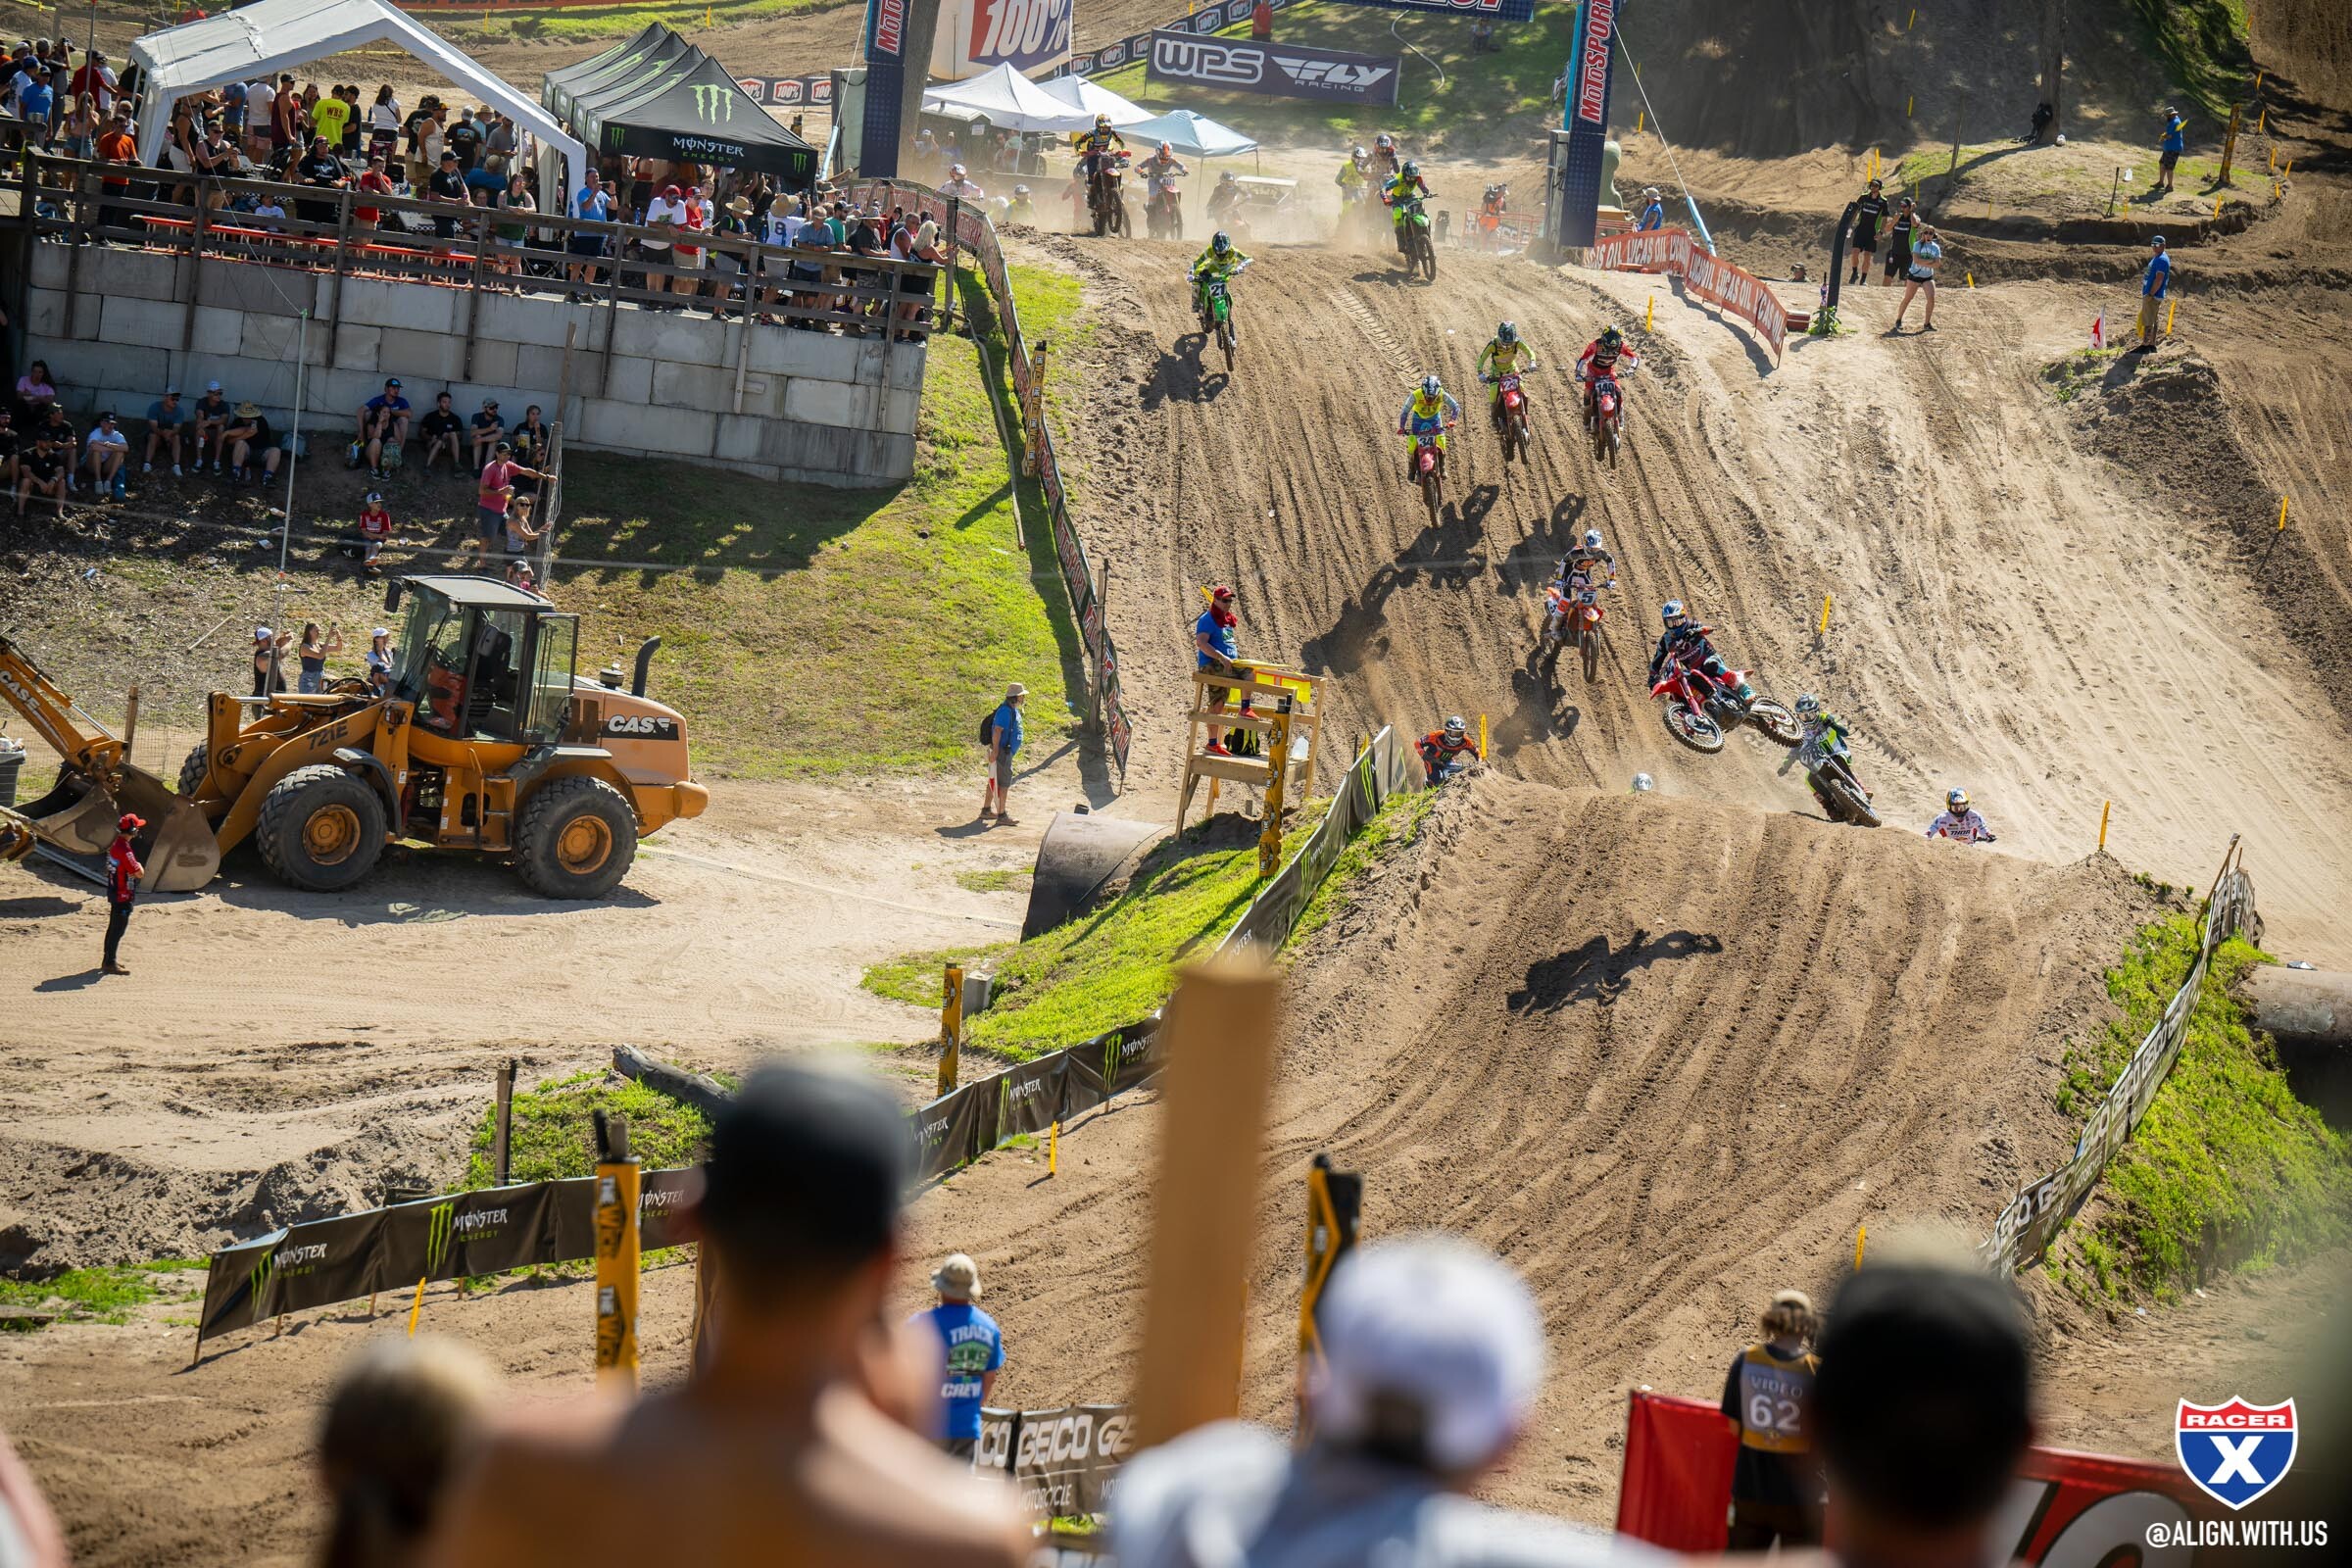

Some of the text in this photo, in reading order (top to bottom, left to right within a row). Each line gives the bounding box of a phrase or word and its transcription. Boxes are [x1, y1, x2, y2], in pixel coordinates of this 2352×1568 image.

[981, 0, 1069, 56] 100%
[1199, 13, 1219, 30] 100%
[1102, 47, 1124, 64] 100%
[1154, 38, 1265, 84] WPS
[1290, 59, 1393, 86] FLY
[776, 85, 800, 98] 100%
[815, 85, 831, 98] 100
[1294, 79, 1364, 93] RACING
[673, 136, 745, 158] MONSTER
[683, 152, 734, 163] ENERGY
[773, 220, 787, 235] 8
[1606, 241, 1623, 269] OIL
[1627, 237, 1653, 266] LUCAS
[1654, 235, 1667, 263] OIL
[1211, 284, 1225, 296] 21
[1716, 266, 1740, 305] LUCAS
[1739, 279, 1753, 310] OIL
[1596, 382, 1615, 393] 140
[1419, 437, 1434, 448] 34
[1581, 592, 1594, 604] 5
[0, 670, 40, 710] CASE
[306, 719, 349, 751] 721E
[600, 1175, 616, 1205] THE
[452, 1207, 508, 1233] MONSTER
[274, 1243, 328, 1270] MONSTER
[599, 1286, 615, 1315] THE
[949, 1324, 995, 1348] TRACK
[941, 1381, 982, 1399] CREW
[1749, 1374, 1803, 1398] VIDEO
[1749, 1394, 1801, 1432] 62
[1015, 1414, 1094, 1468] GEICO
